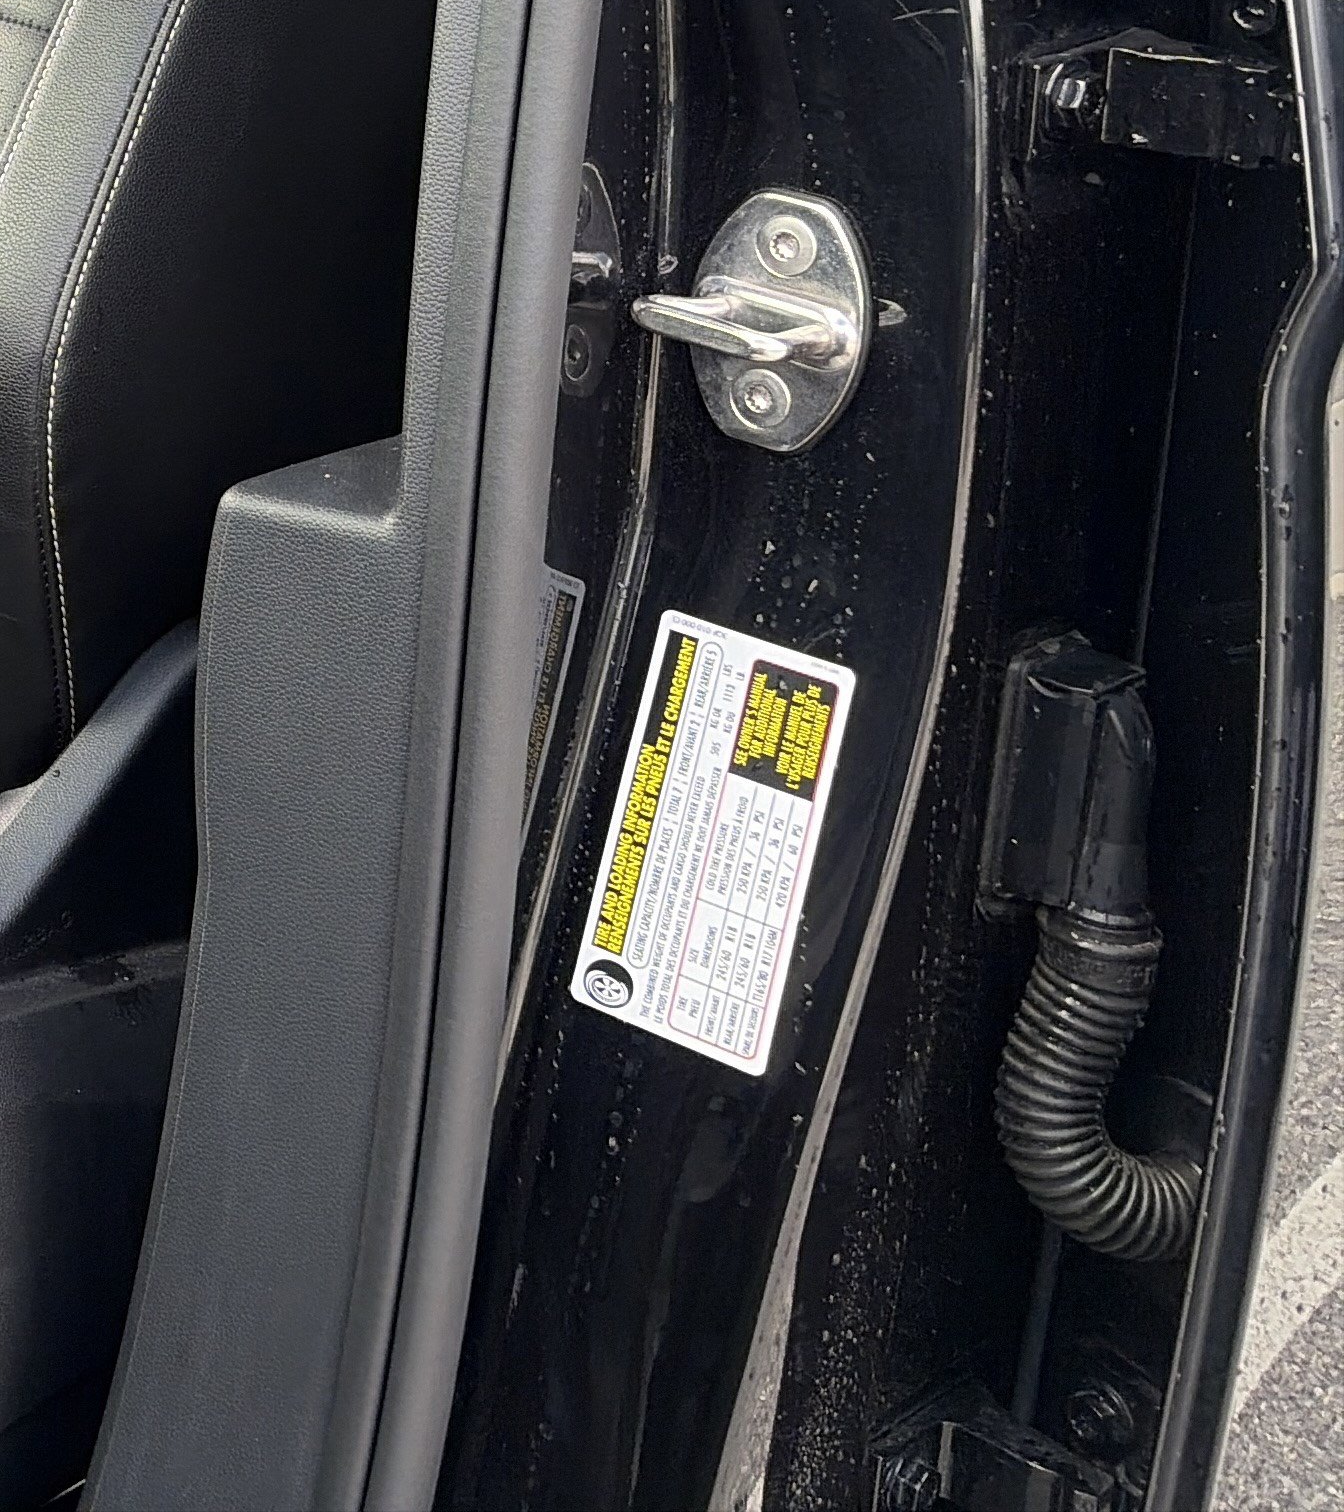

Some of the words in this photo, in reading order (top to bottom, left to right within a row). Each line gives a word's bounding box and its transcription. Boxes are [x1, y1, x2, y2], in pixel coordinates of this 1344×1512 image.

[665, 640, 694, 721] CHARGEMENT
[722, 664, 733, 676] LBS
[750, 675, 767, 709] MANUAL
[792, 692, 806, 704] DE
[806, 686, 821, 698] DE
[754, 689, 776, 739] ADDITIONAL
[801, 697, 818, 721] PLUS
[661, 722, 675, 737] LE
[739, 710, 758, 749] OWNER'S
[763, 698, 787, 756] INFORMATION
[784, 705, 803, 741] MANUEL
[795, 720, 812, 746] POUR
[655, 738, 671, 753] ET
[678, 727, 698, 776] FRONT/AVANT
[748, 739, 764, 758] FOR
[782, 741, 794, 752] LE
[802, 704, 830, 779] RENSEIGNEMENTS
[735, 750, 748, 766] SEE
[777, 752, 791, 774] VOIR
[788, 746, 807, 790] L'USAGER
[646, 754, 667, 796] PNEUS
[624, 745, 655, 832] INFORMATION
[691, 776, 705, 801] EXCEED
[640, 795, 656, 818] LES
[667, 794, 681, 815] TOTAL
[686, 801, 698, 823] NEVER
[753, 810, 765, 824] PSI
[772, 817, 785, 831] PSI
[634, 818, 651, 845] SUR
[658, 827, 672, 853] PLACES
[714, 823, 729, 856] PRESSURE
[728, 825, 741, 847] PNEUS
[791, 824, 803, 838] PSI
[611, 833, 633, 890] LOADING
[655, 853, 666, 864] DE
[673, 852, 686, 875] CARGO
[709, 856, 720, 871] TIRE
[725, 848, 736, 861] DES
[717, 862, 732, 895] PRESSION
[741, 862, 753, 877] KPA
[760, 869, 772, 884] KPA
[705, 872, 717, 891] COLD
[736, 877, 749, 894] 250
[779, 876, 791, 891] KPA
[608, 846, 643, 952] RENSEIGNEMENTS
[639, 865, 663, 931] CAPACITY/NOMBRE
[755, 885, 769, 902] 250
[775, 892, 787, 908] 420
[603, 891, 618, 921] AND
[660, 893, 676, 931] OCCUPANTS
[596, 922, 611, 947] TIRE
[632, 932, 647, 962] SEATING
[716, 950, 732, 981] 245/60
[735, 957, 750, 988] 245/60
